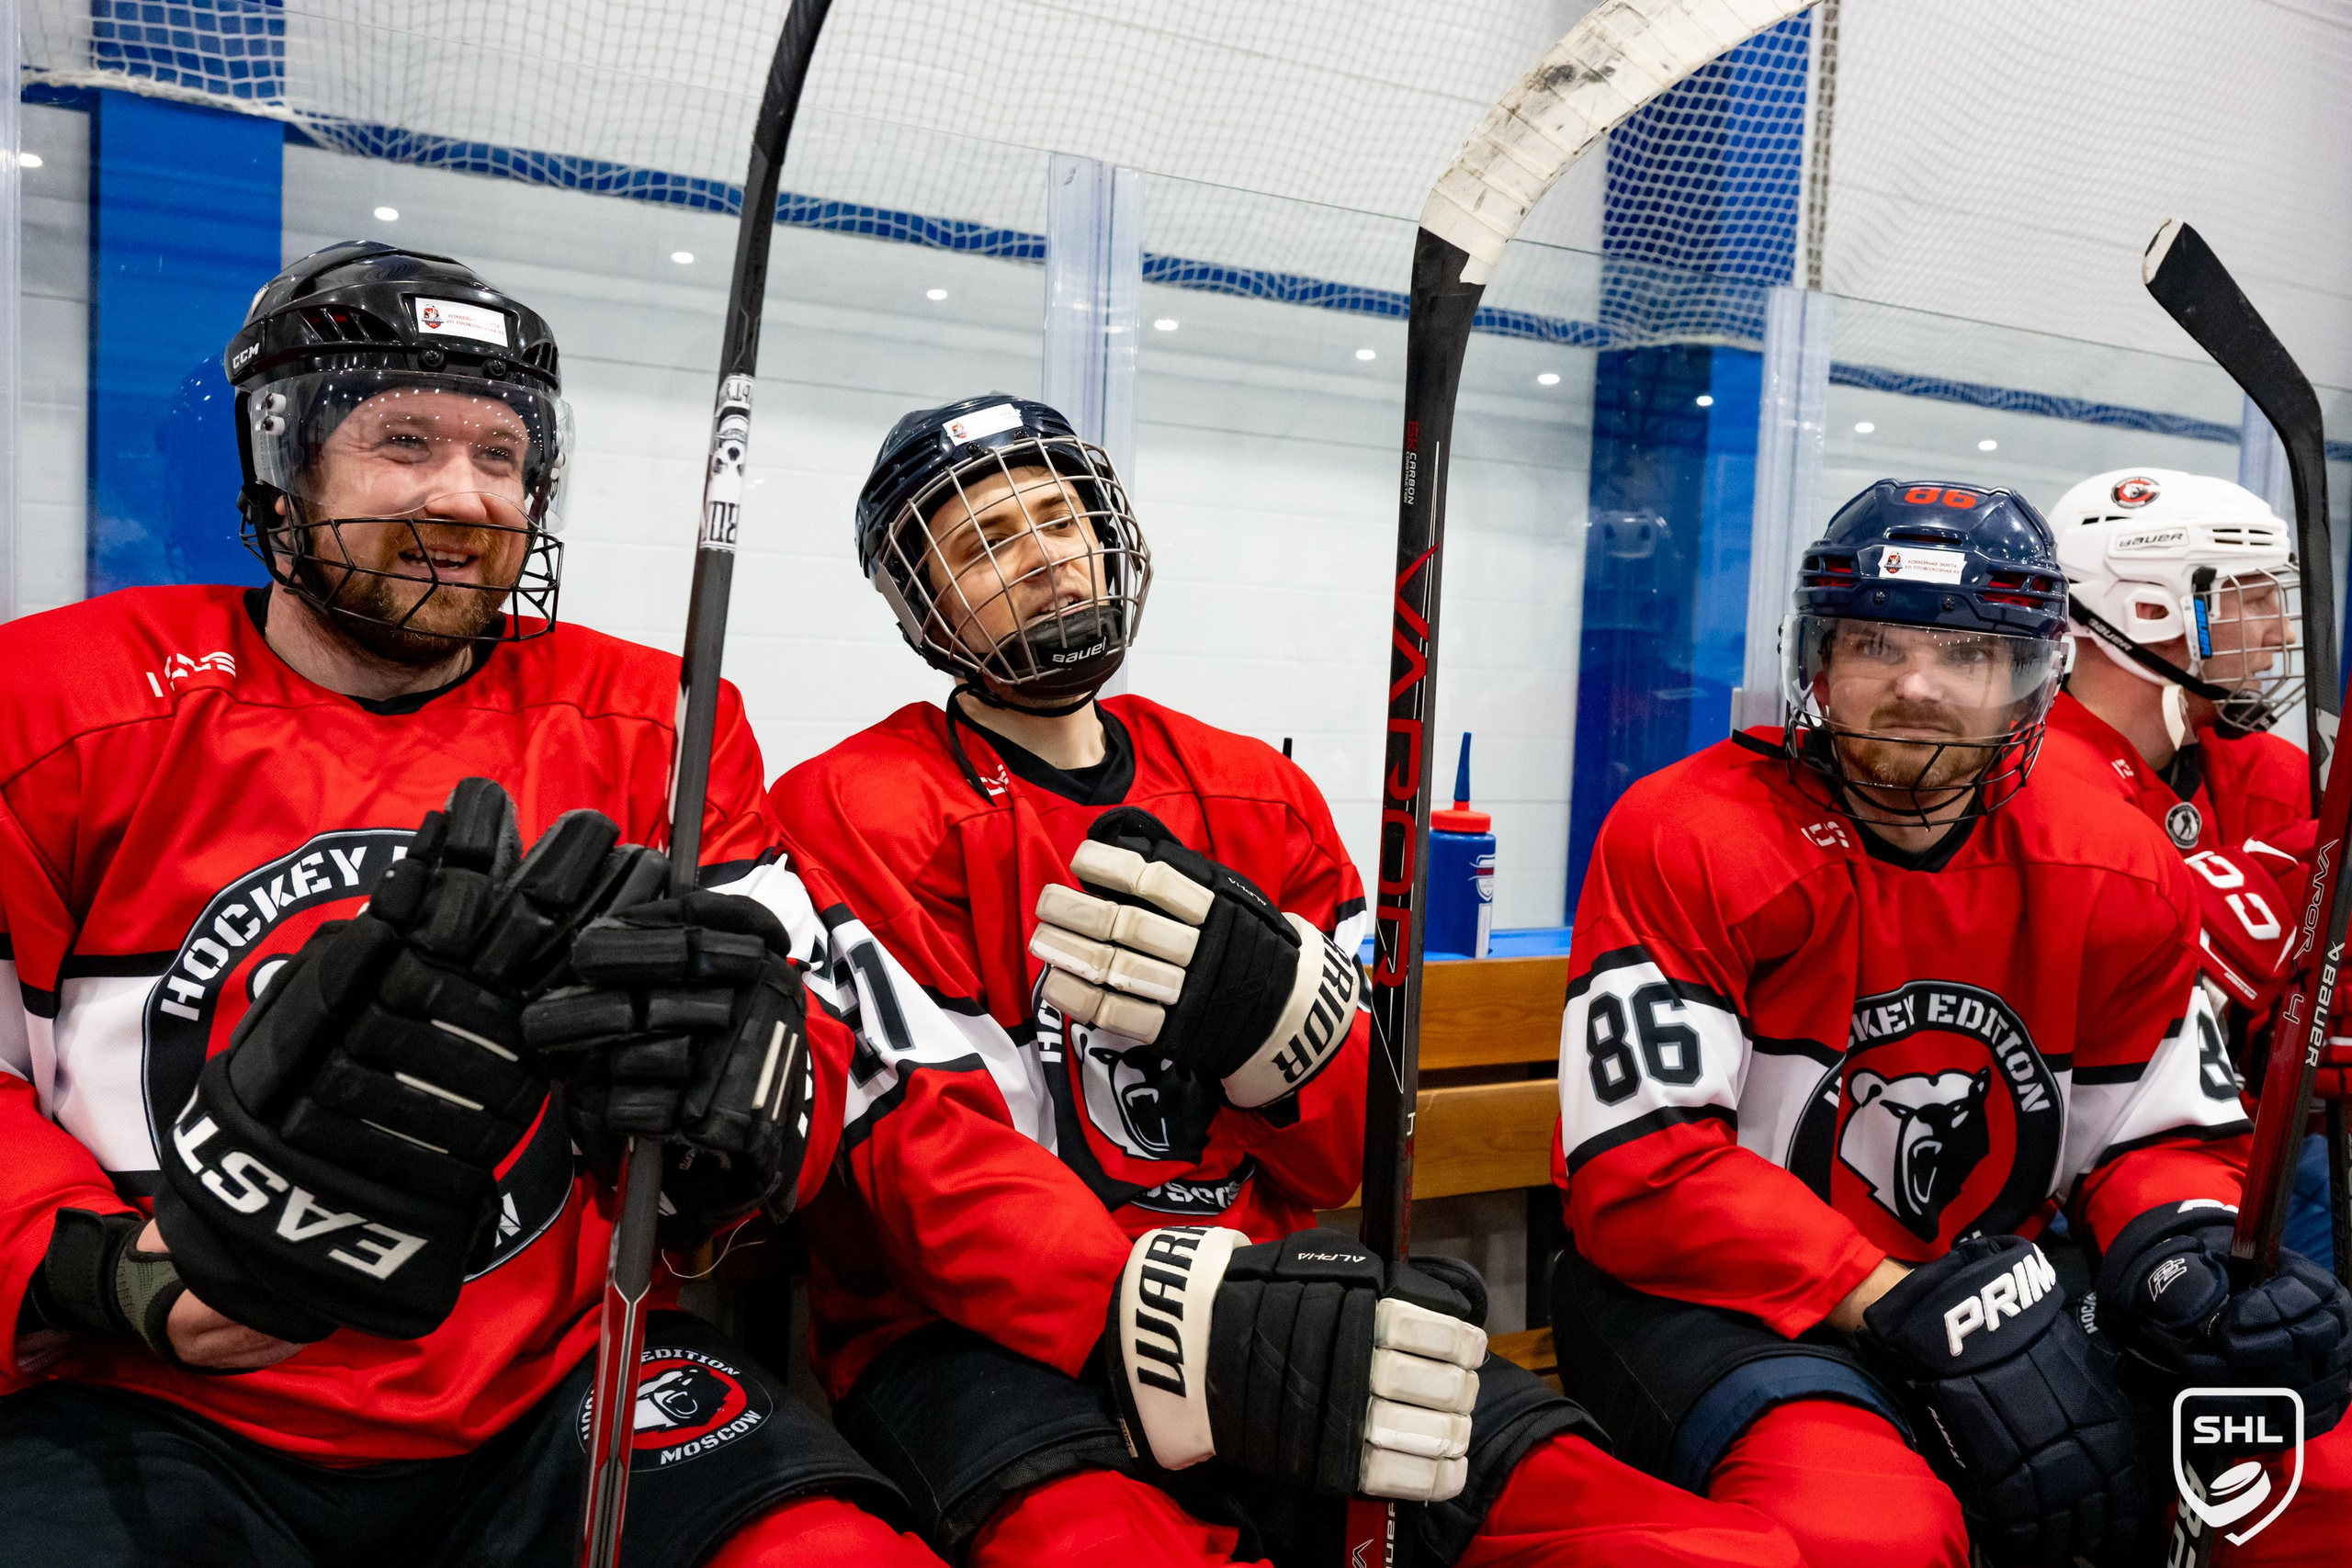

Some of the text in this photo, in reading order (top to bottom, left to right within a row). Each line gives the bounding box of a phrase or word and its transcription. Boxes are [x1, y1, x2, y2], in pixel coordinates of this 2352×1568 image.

[232, 343, 260, 369] CCM
[1408, 452, 1417, 505] CARBON
[1905, 487, 1979, 509] 86
[1052, 636, 1107, 663] BAUE
[2087, 617, 2133, 652] BAUER
[2194, 598, 2212, 657] BAUER
[1372, 541, 1442, 992] VAPOR
[2293, 838, 2340, 961] VAPOR
[160, 846, 368, 1021] HOCKEY
[1587, 981, 1704, 1108] 86
[2304, 964, 2337, 1068] BAUER
[1928, 993, 2051, 1113] EDITION
[173, 1084, 428, 1280] EAST
[1297, 1252, 1366, 1263] ALPHA
[1136, 1225, 1216, 1398] WAR
[2080, 1292, 2099, 1335] HOCK
[641, 1348, 741, 1376] EDITION
[660, 1409, 763, 1465] MOSCOW
